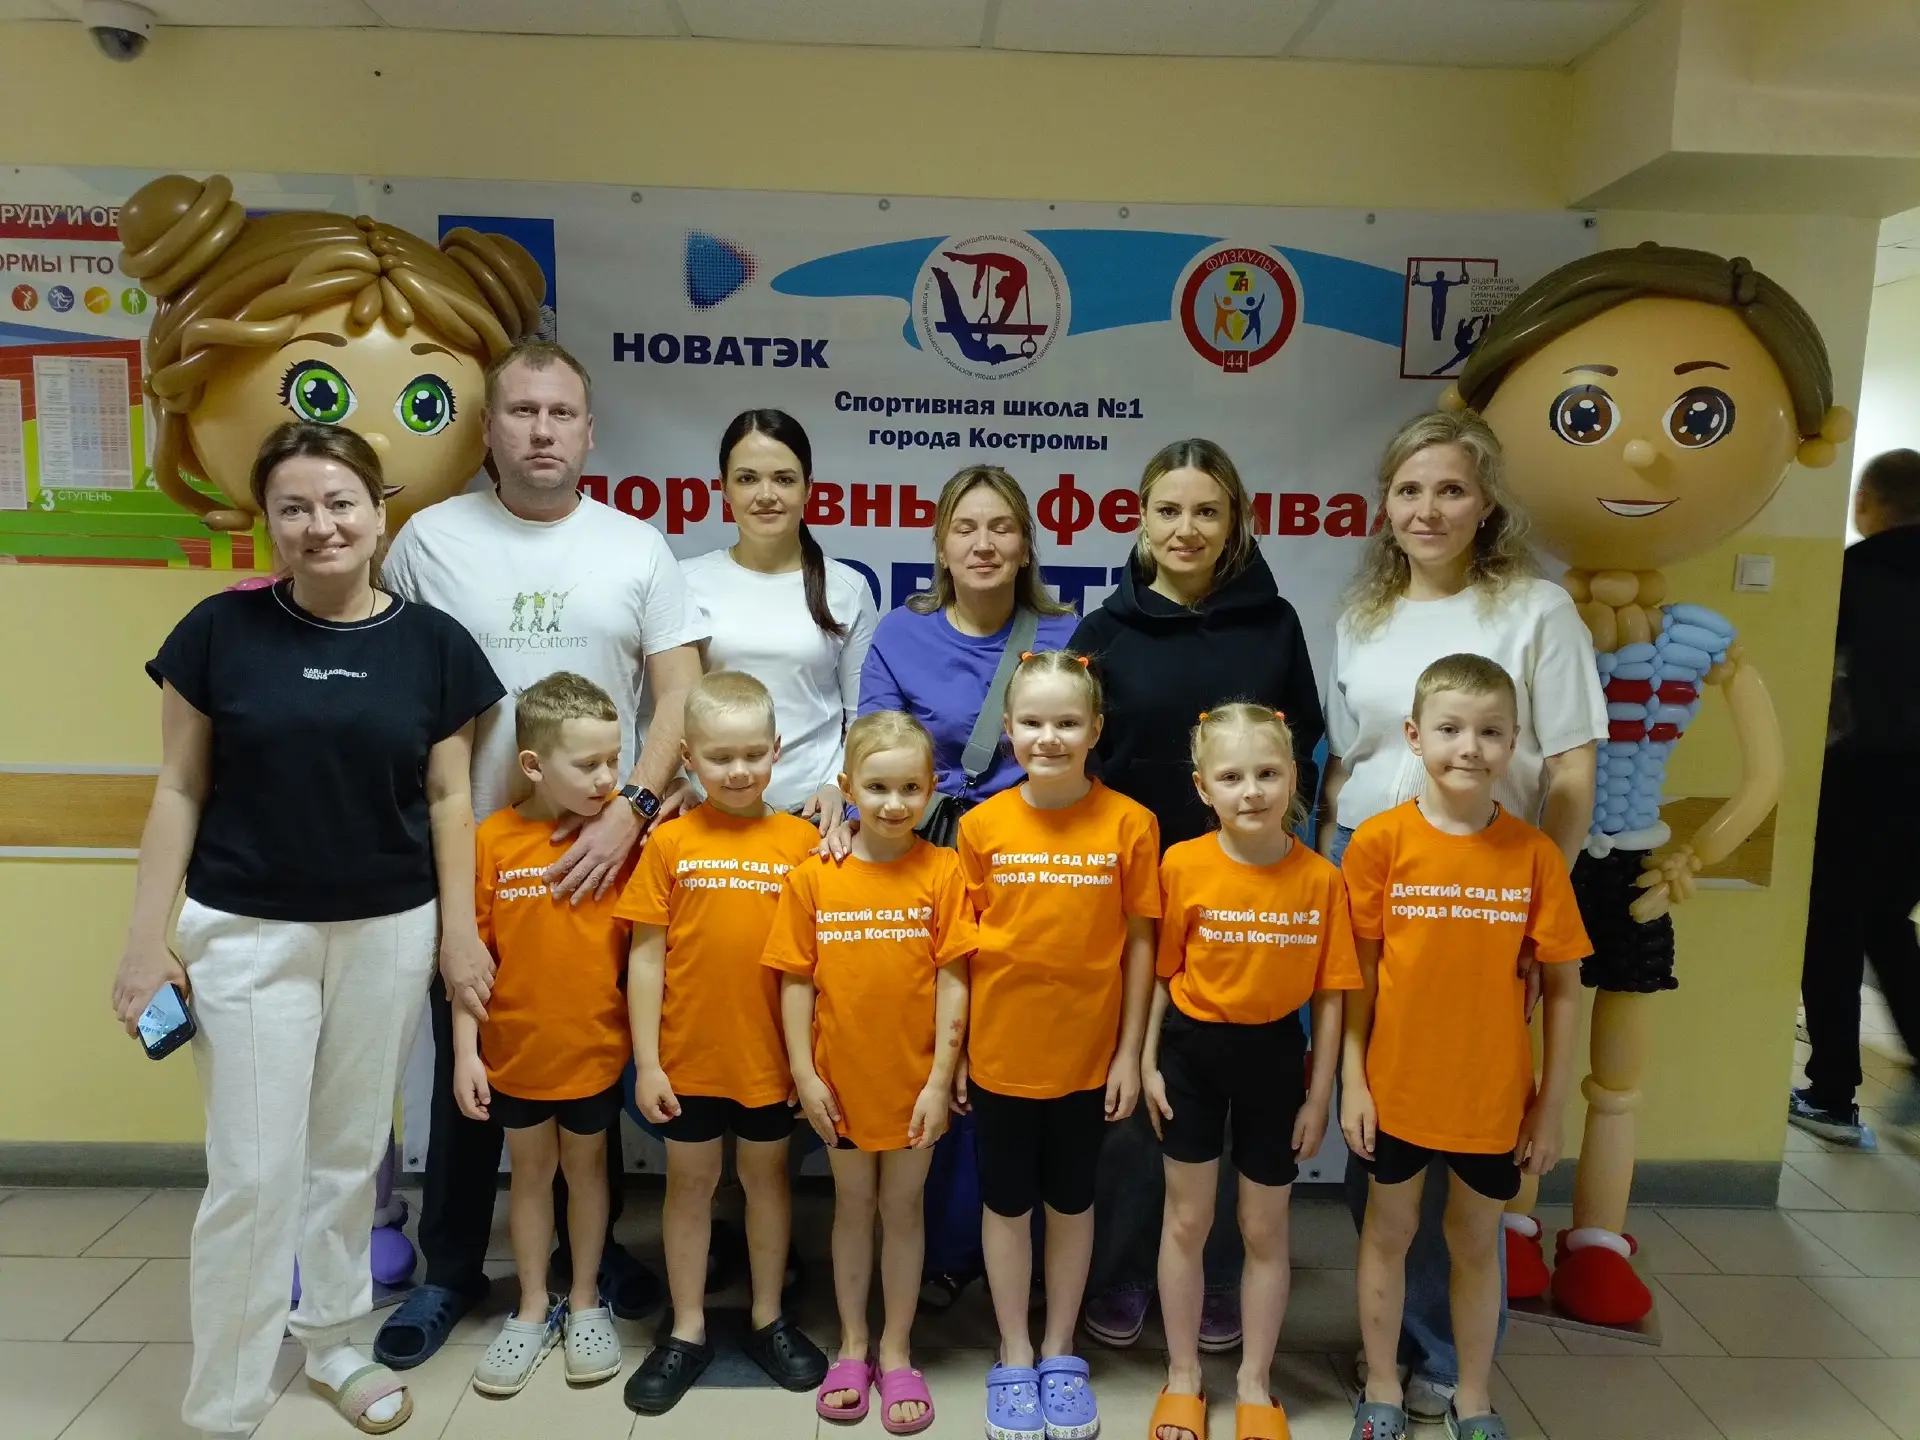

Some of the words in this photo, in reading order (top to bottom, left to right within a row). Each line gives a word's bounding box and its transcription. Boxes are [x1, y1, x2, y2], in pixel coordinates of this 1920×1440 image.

[67, 205, 83, 226] И
[70, 255, 114, 276] ГТО
[1205, 250, 1281, 274] ФИЗКУЛЬТ
[1471, 277, 1514, 285] ФЕДЕРАЦИЯ
[613, 332, 830, 369] НОВАТЭК
[1227, 354, 1244, 369] 44
[834, 390, 995, 417] Спортивная
[1003, 398, 1089, 418] школа
[1097, 398, 1144, 419] №1
[869, 428, 960, 450] города
[969, 427, 1108, 453] Костромы
[40, 489, 55, 511] 3
[57, 490, 112, 502] СТУПЕНЬ
[478, 633, 526, 652] Henry
[303, 667, 323, 675] KARL
[677, 858, 739, 873] Детский
[742, 860, 770, 874] сад
[991, 852, 1049, 866] Детский
[1052, 854, 1082, 867] сад
[1087, 853, 1118, 868] №2
[993, 871, 1036, 886] города
[1039, 871, 1113, 887] Костромы
[1390, 883, 1461, 898] Детский
[1465, 887, 1498, 902] сад
[1501, 887, 1532, 902] №2
[876, 909, 904, 921] сад
[1259, 910, 1289, 925] сад
[1293, 909, 1320, 925] №2
[1392, 905, 1447, 920] города
[817, 930, 861, 944] орода
[1199, 926, 1244, 942] города
[1247, 930, 1318, 947] Костромы
